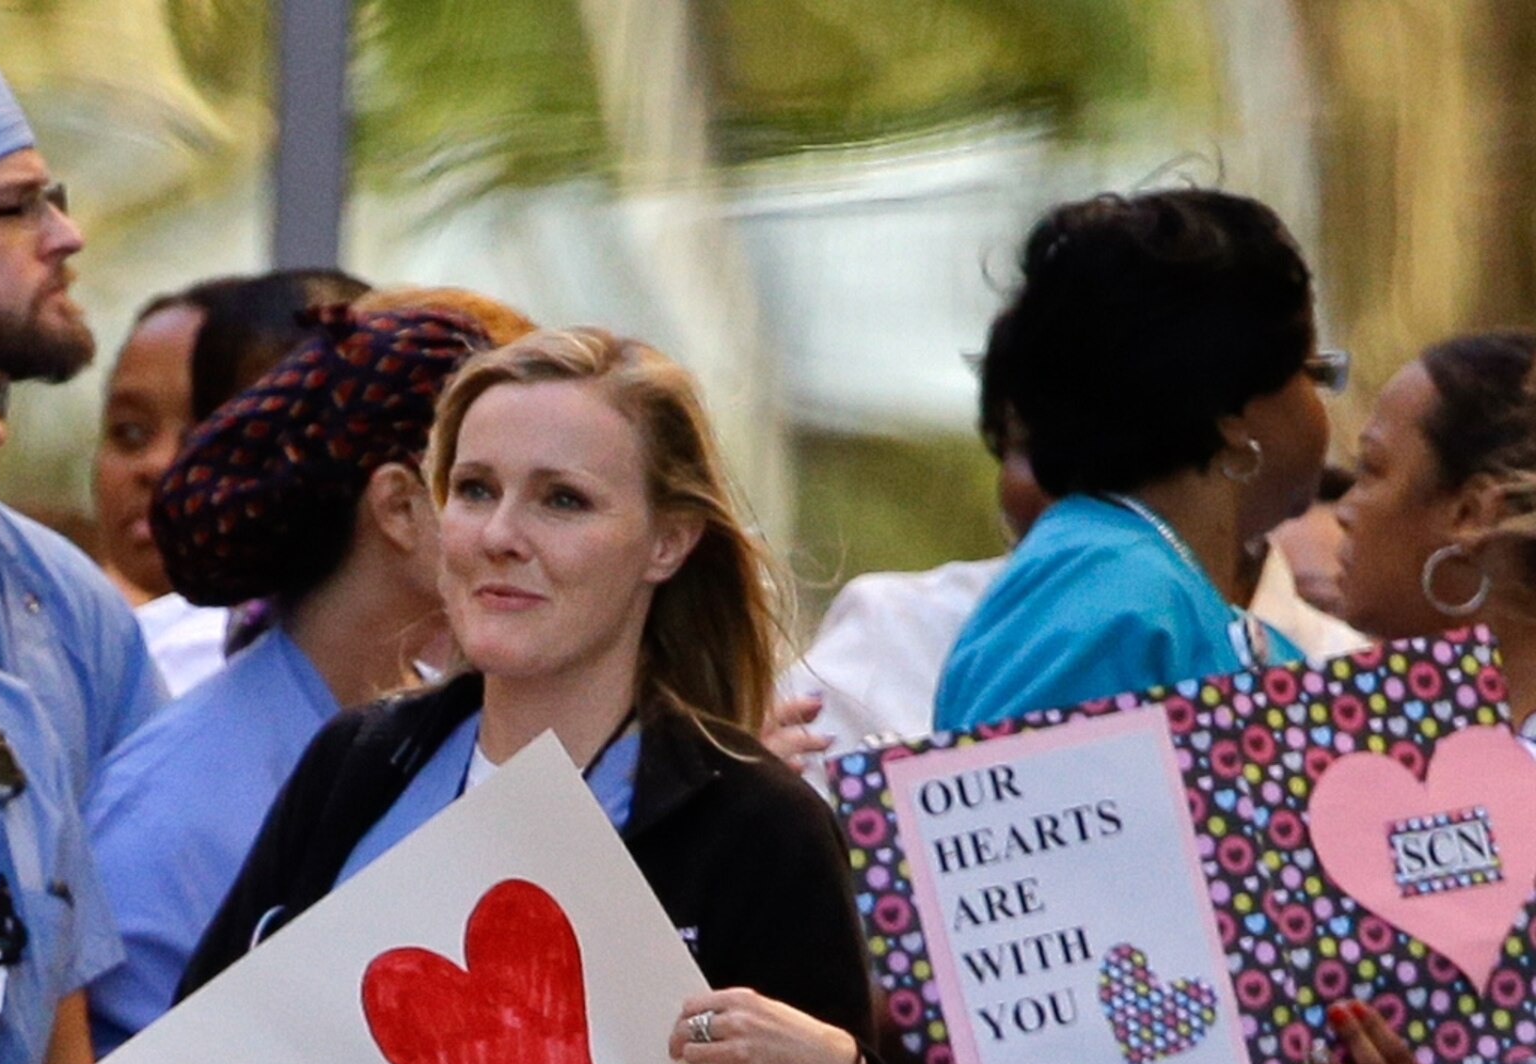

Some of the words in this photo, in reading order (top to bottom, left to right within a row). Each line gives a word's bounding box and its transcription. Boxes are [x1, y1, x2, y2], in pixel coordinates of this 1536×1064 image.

[919, 764, 1022, 817] OUR
[932, 800, 1124, 875] HEARTS
[1400, 822, 1490, 876] SCN
[952, 878, 1045, 933] ARE
[962, 927, 1094, 988] WITH
[975, 988, 1079, 1043] YOU
